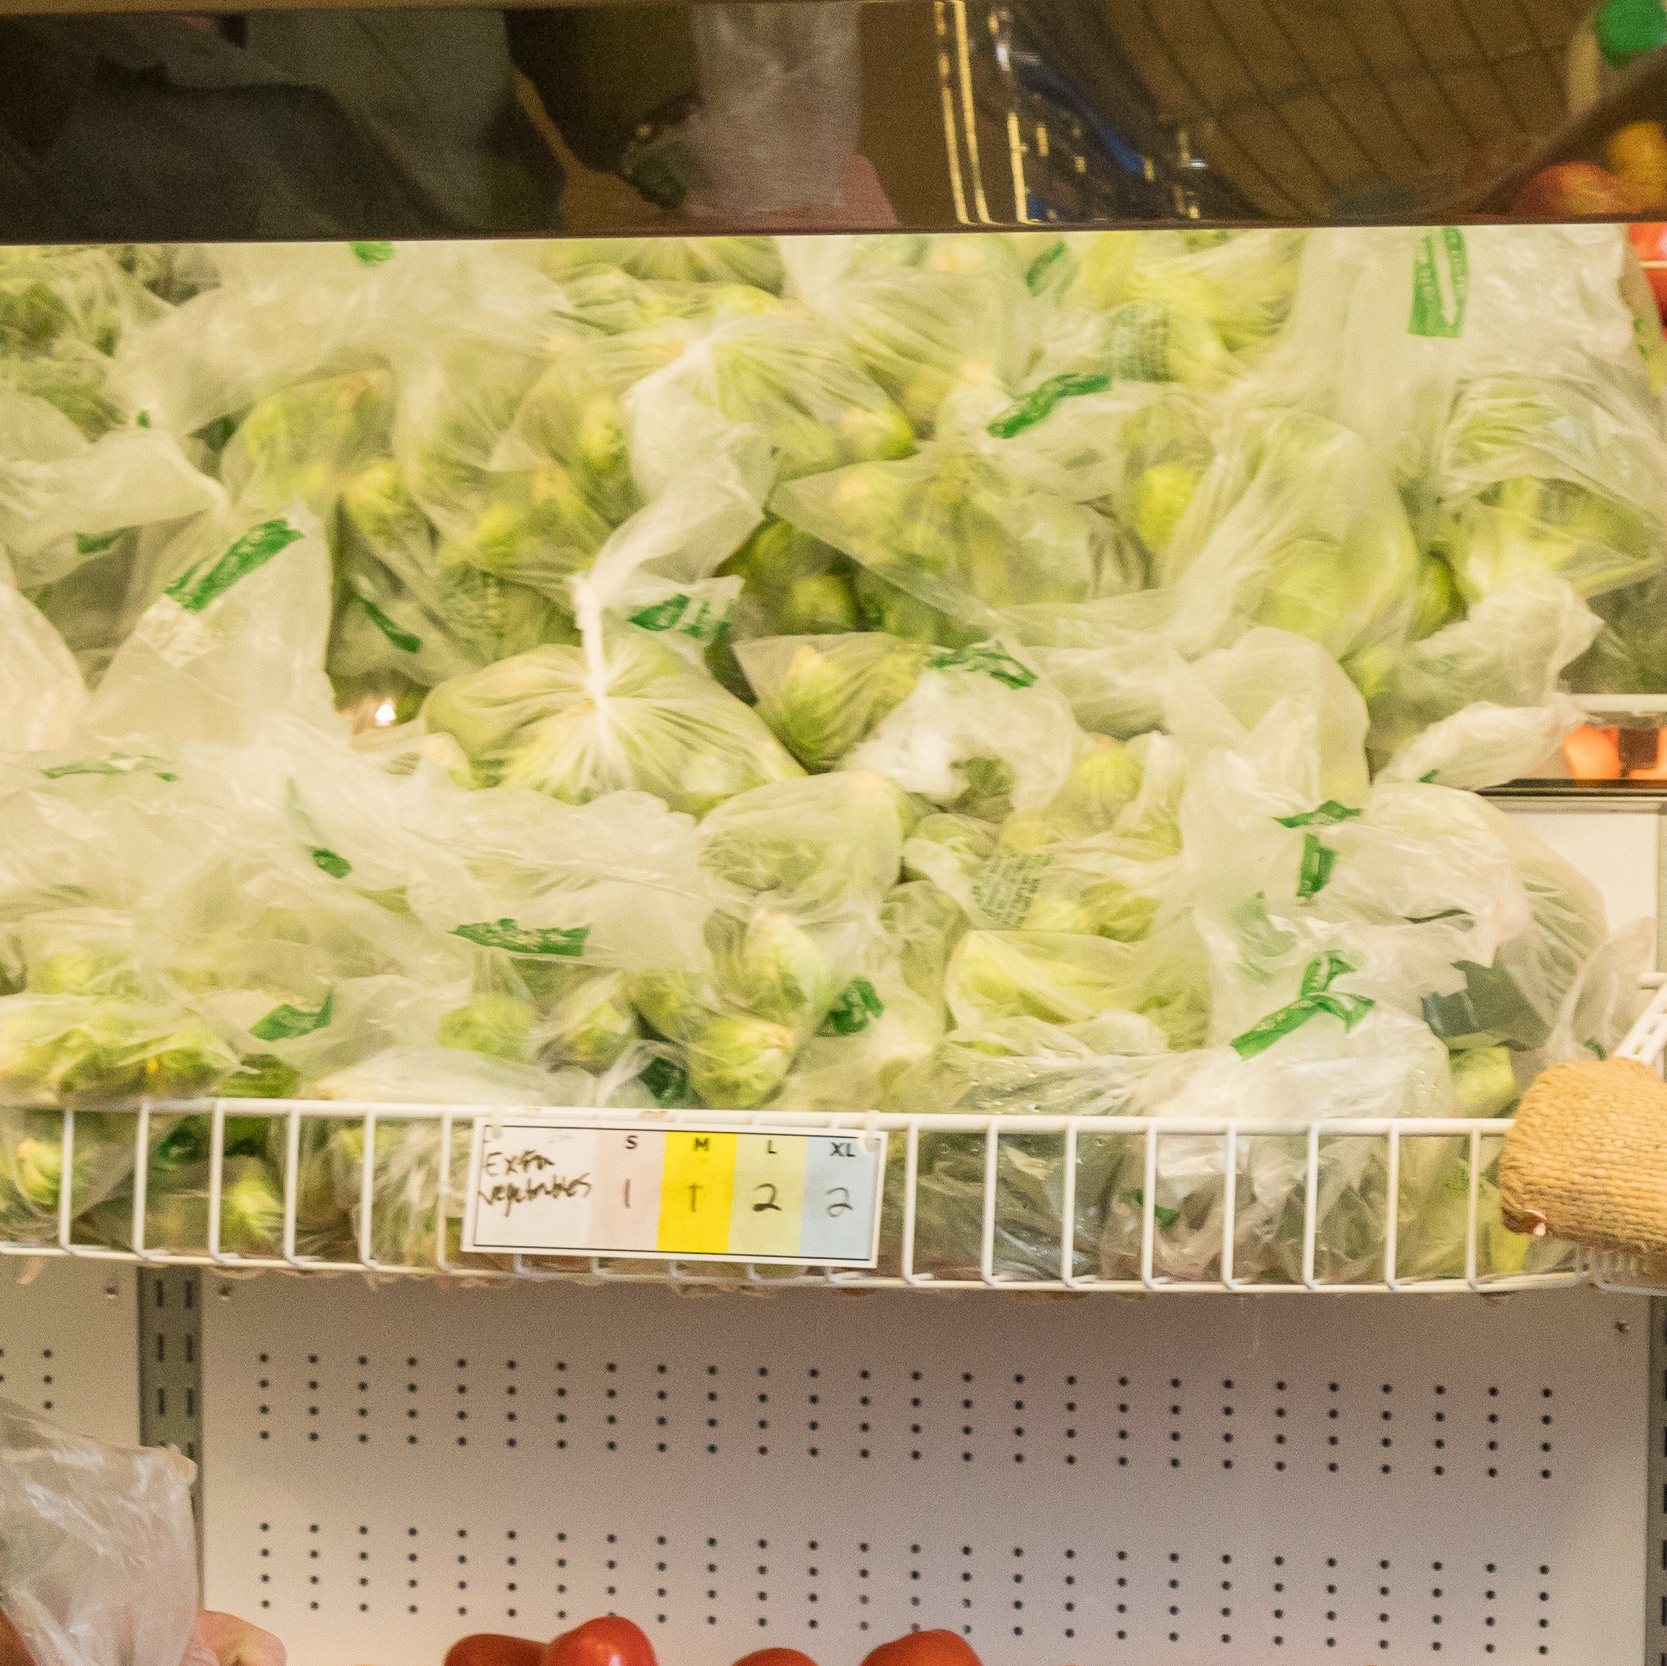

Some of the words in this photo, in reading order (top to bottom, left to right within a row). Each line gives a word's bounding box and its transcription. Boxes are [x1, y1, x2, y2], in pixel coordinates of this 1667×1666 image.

[625, 1135, 639, 1150] S
[692, 1137, 710, 1152] M
[767, 1139, 778, 1154] L
[830, 1142, 856, 1157] XL
[752, 1183, 782, 1212] 2
[826, 1187, 853, 1217] 2
